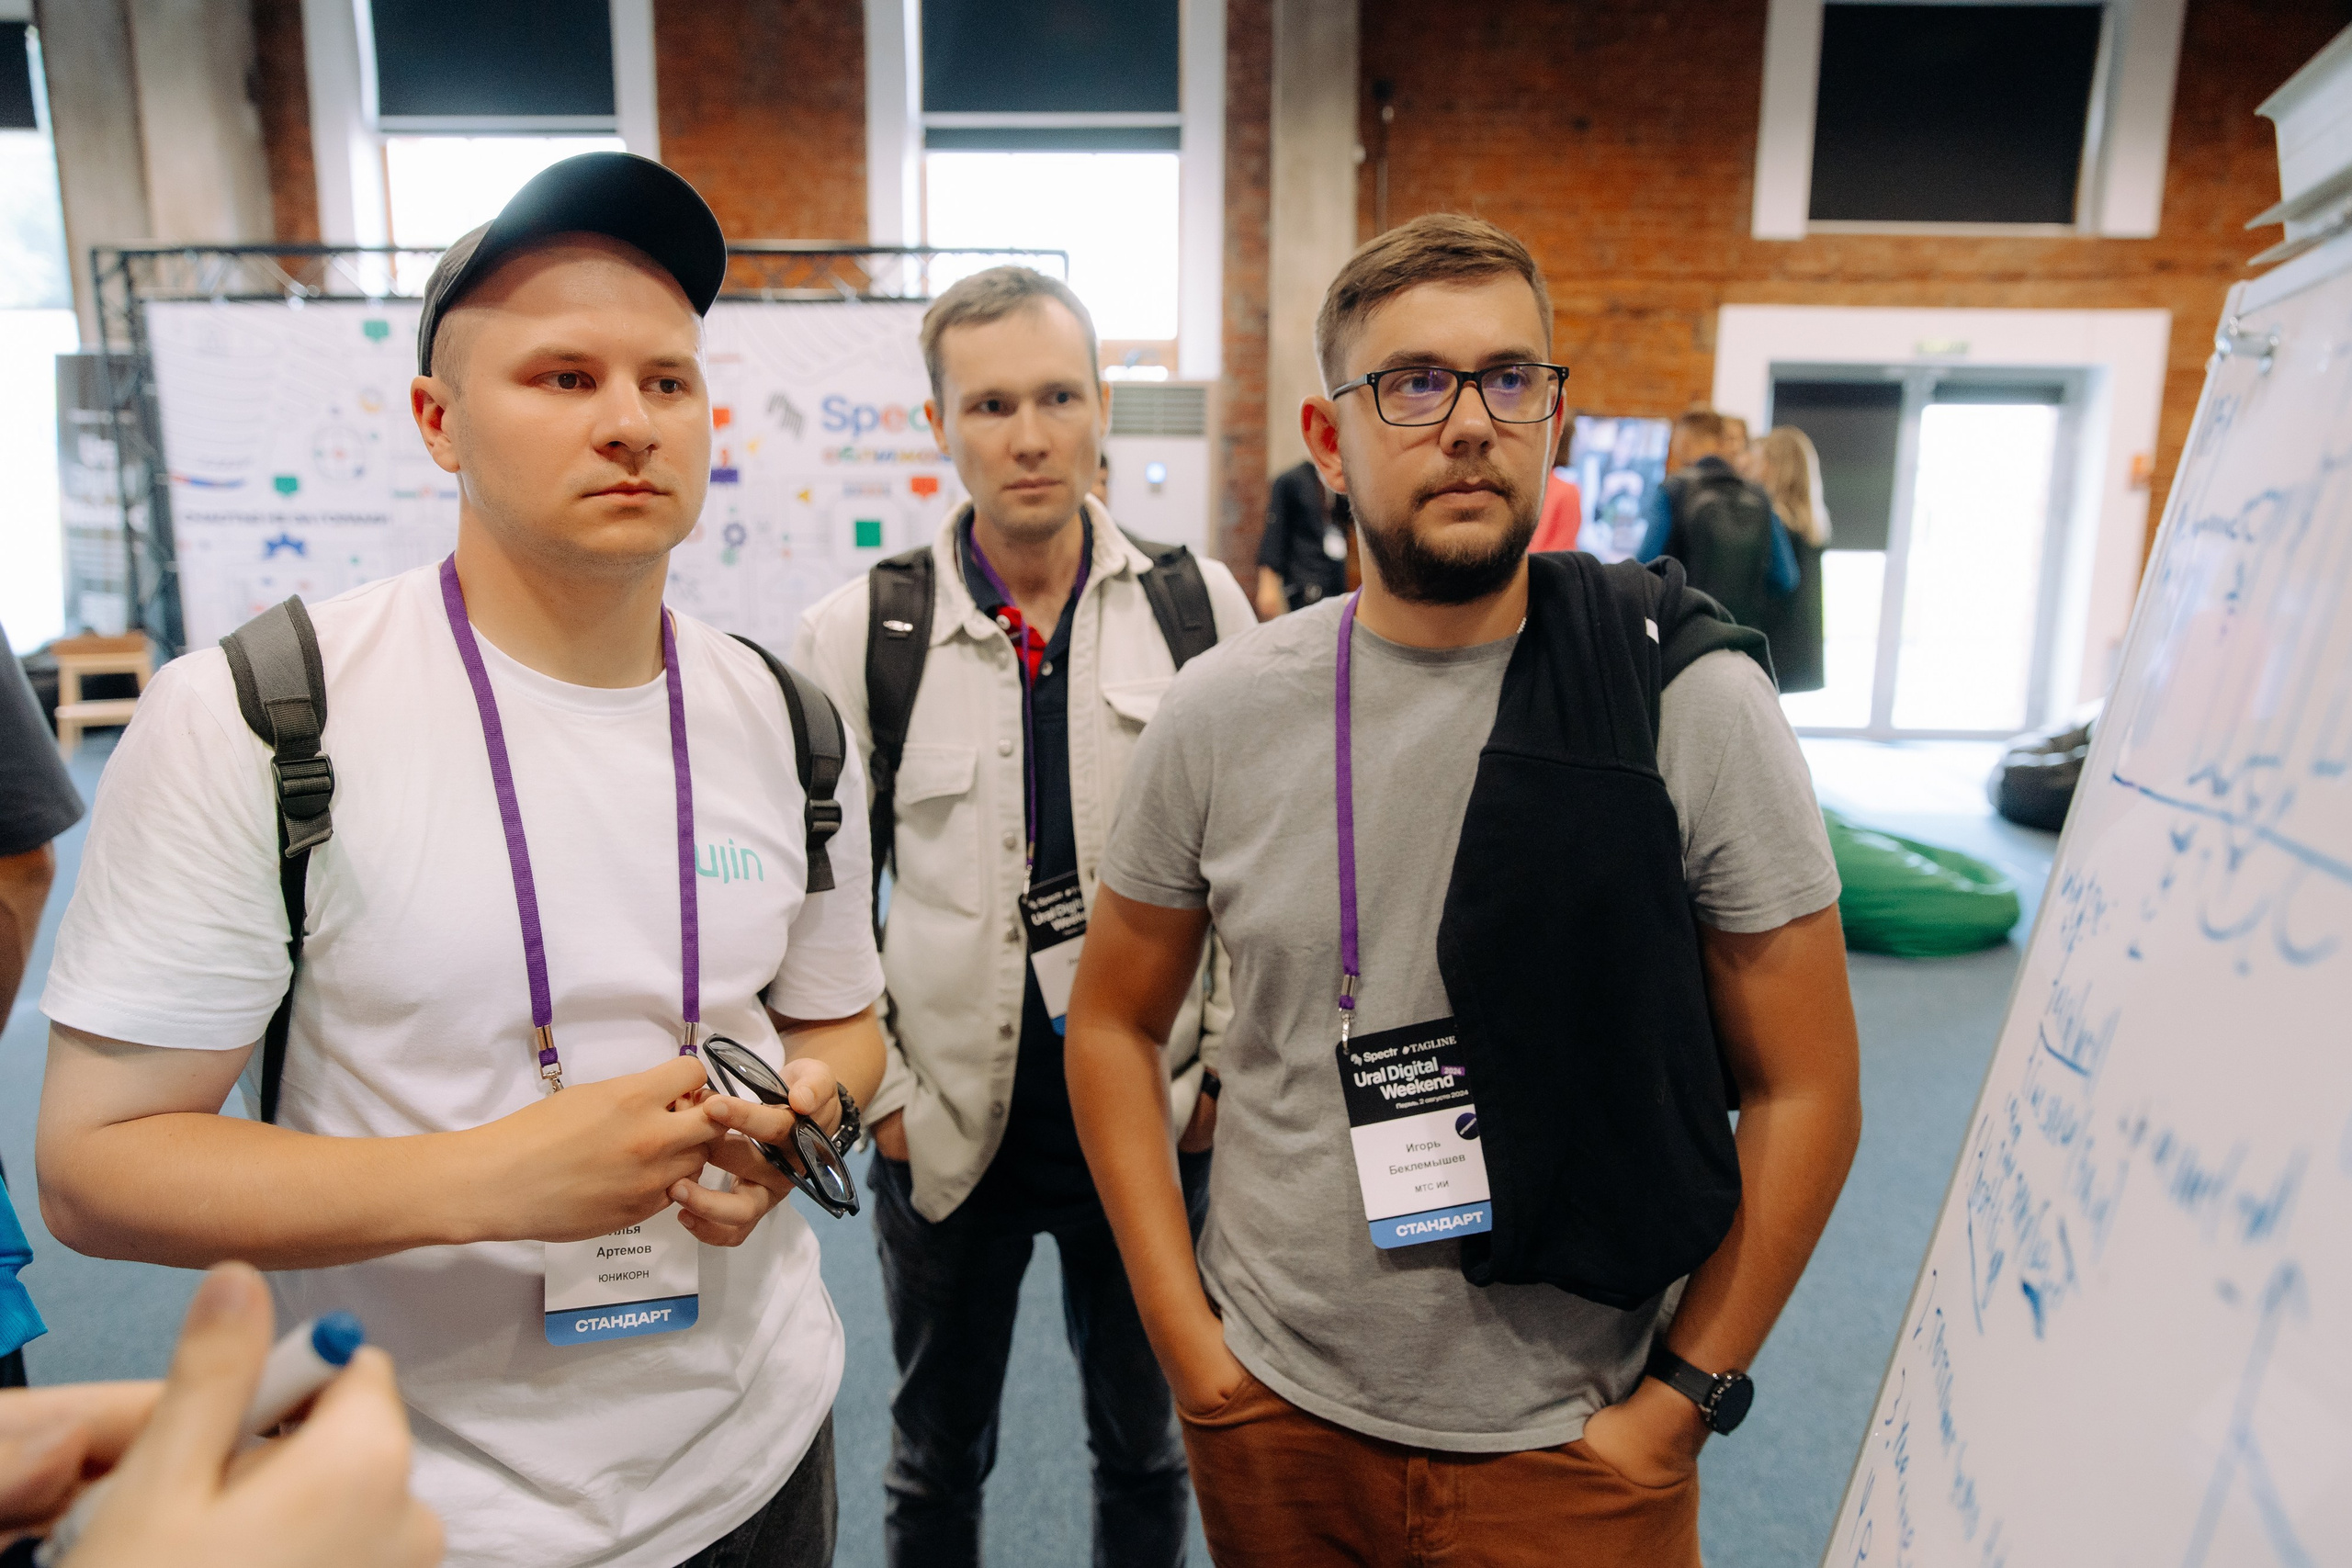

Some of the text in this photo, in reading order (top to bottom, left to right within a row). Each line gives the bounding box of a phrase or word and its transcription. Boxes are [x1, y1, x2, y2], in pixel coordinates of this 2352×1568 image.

[821, 394, 932, 439] Spec
[695, 838, 763, 884] ujin
[1363, 1035, 1457, 1063] Spectr TAGLINE
[1353, 1056, 1439, 1088] Ural Digital
[1380, 1074, 1454, 1100] Weekend
[1406, 1141, 1441, 1153] Игорь
[1389, 1154, 1465, 1175] Беклемышев
[1415, 1180, 1450, 1192] МТС ИИ
[608, 1225, 640, 1236] лья
[1396, 1211, 1483, 1237] СТАНДАРТ
[596, 1245, 651, 1259] Артемов
[598, 1270, 650, 1283] ЮНИКОРН
[575, 1309, 672, 1332] СТАНДАРТ
